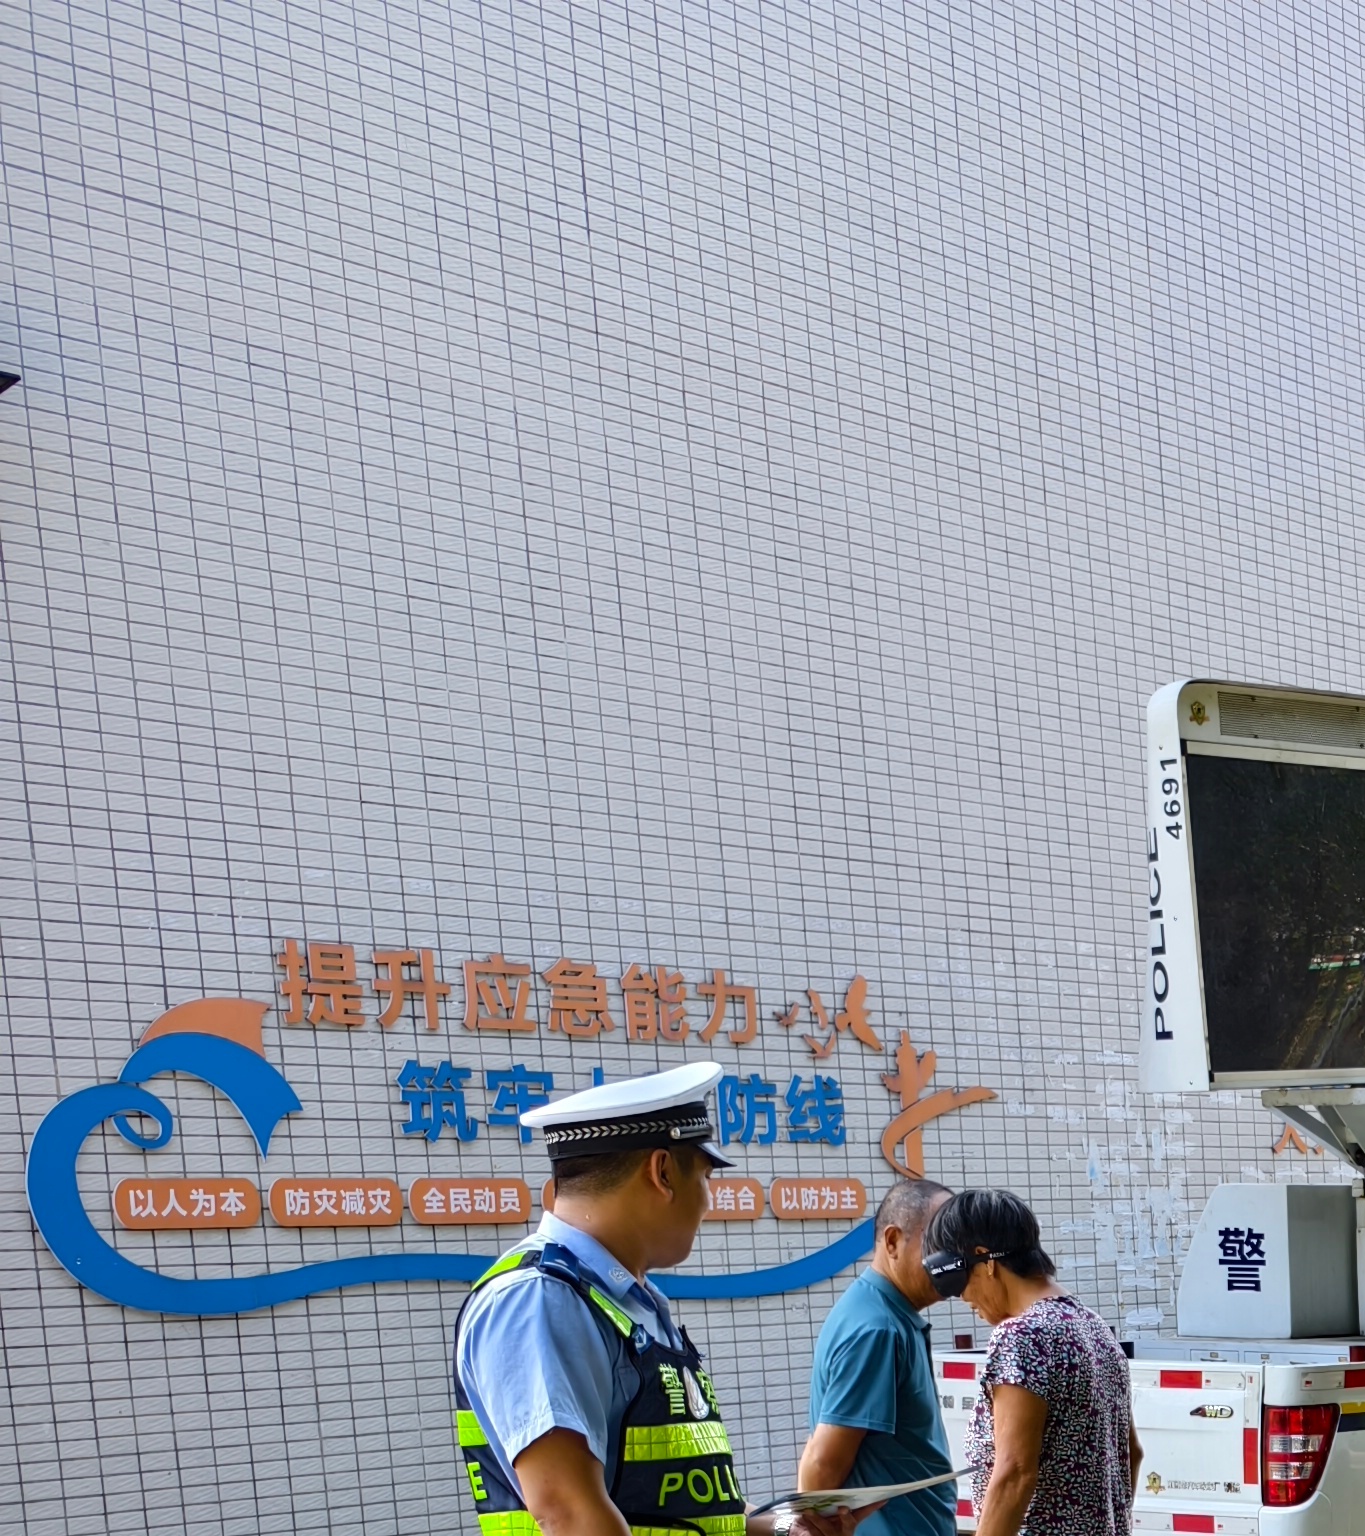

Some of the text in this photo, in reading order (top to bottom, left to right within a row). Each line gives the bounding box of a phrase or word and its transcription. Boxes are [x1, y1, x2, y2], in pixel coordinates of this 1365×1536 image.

[1160, 757, 1183, 840] 4691
[1148, 827, 1174, 1041] POLICE
[276, 938, 759, 1045] 提升应急能力
[396, 1058, 847, 1147] 筑牢防线
[128, 1188, 248, 1218] 以人为本
[285, 1187, 393, 1216] 防灾减灾
[422, 1186, 522, 1214] 全民动员
[780, 1186, 859, 1211] 以防为主
[1217, 1227, 1267, 1292] 警
